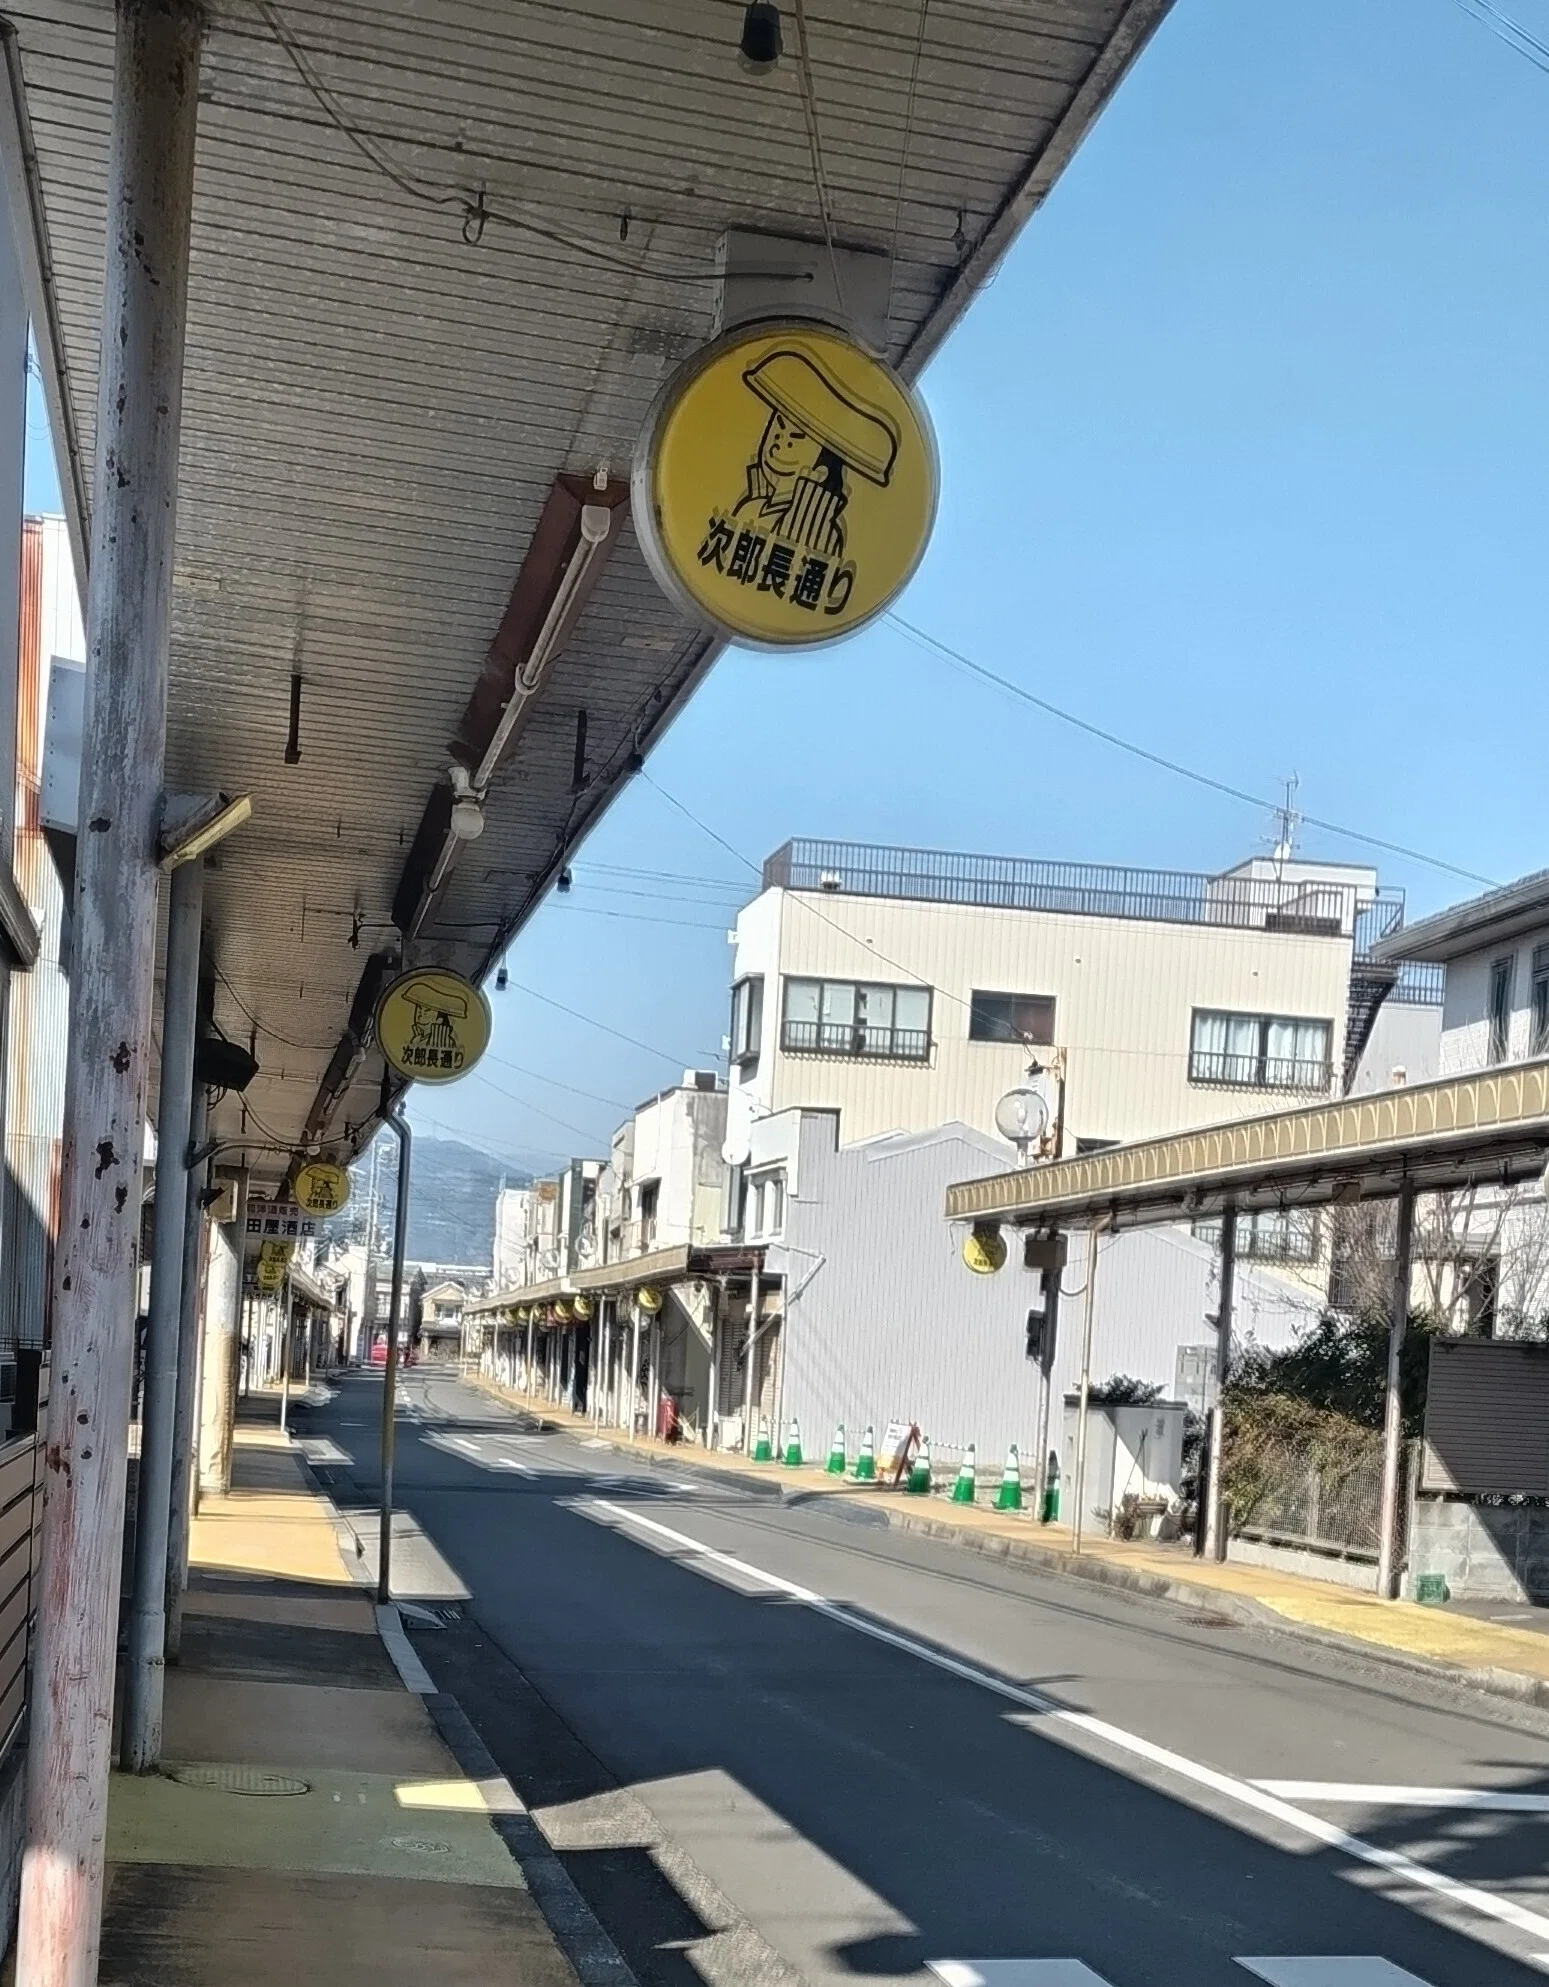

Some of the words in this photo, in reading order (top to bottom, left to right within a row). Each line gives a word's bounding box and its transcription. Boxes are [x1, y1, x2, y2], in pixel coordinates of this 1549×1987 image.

[696, 515, 854, 616] 次郎長通り
[401, 1045, 465, 1069] 次郎長通り
[247, 1219, 316, 1236] 田屋酒店
